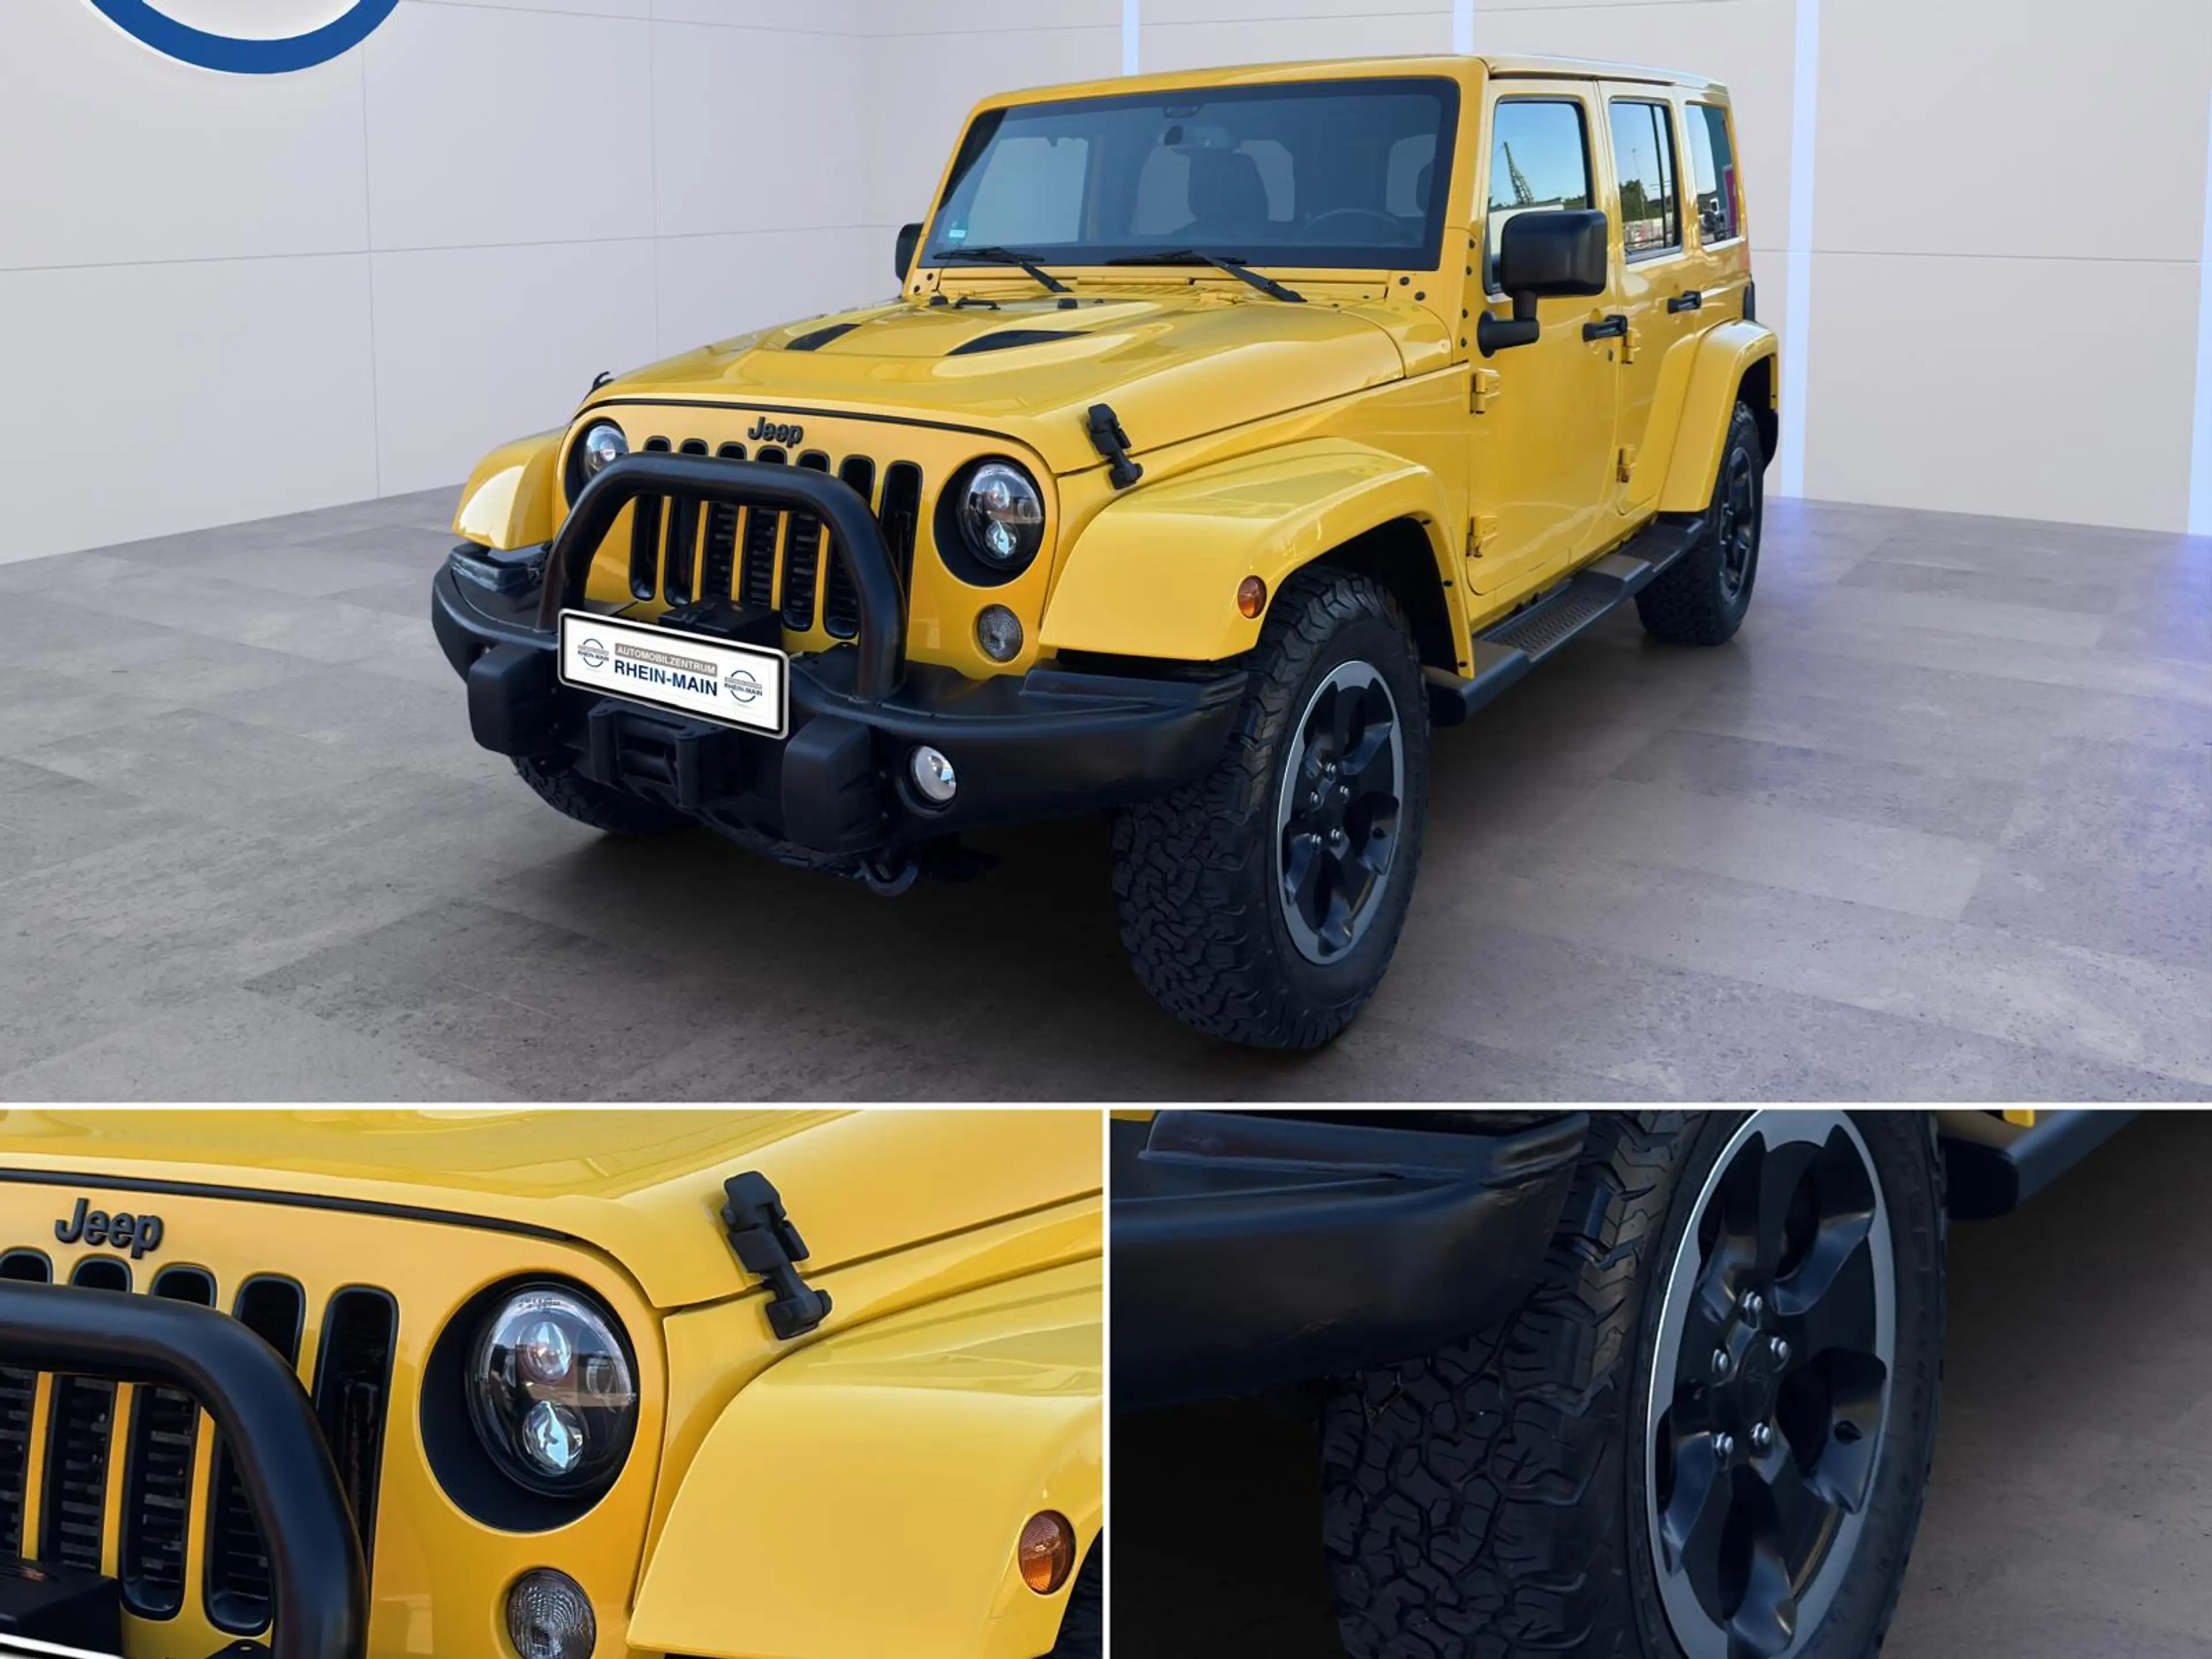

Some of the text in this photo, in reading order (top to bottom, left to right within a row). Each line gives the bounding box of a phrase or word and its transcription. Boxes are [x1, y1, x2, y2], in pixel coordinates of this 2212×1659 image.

[748, 416, 804, 448] Jeep
[615, 659, 717, 696] RHEIN-MAIN
[616, 646, 716, 675] AUTOMOBILZENTRUM
[55, 1197, 164, 1260] Jeep
